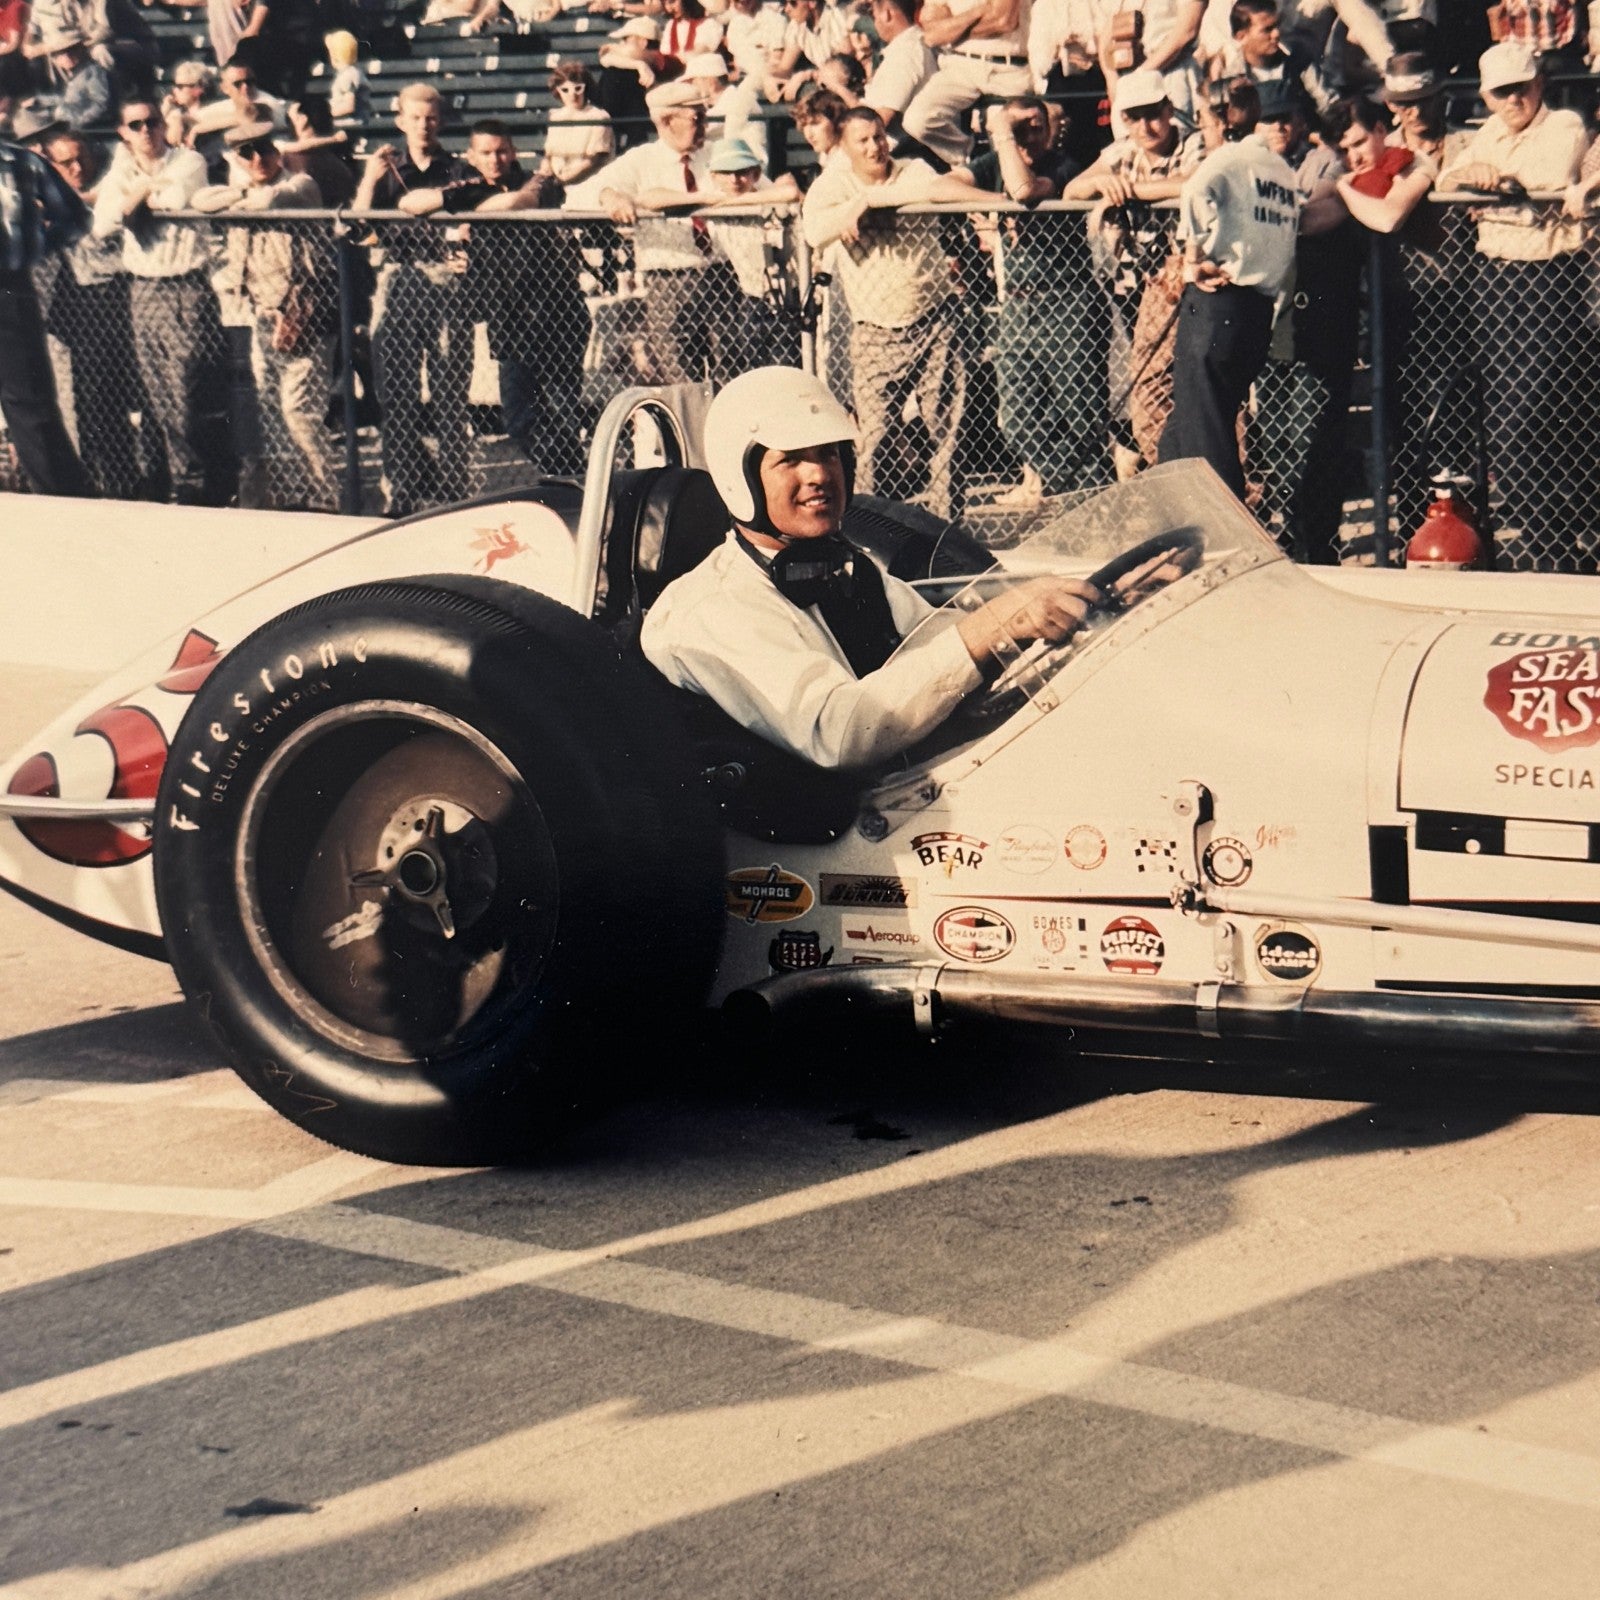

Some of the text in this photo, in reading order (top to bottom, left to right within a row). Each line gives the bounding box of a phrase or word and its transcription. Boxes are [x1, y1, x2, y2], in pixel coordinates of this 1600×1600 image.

[1507, 686, 1600, 737] FAS
[170, 637, 368, 831] Firestone
[211, 680, 332, 802] DELUXE CHAMPION
[1495, 764, 1595, 789] SPECIA
[917, 845, 983, 870] BEAR
[742, 886, 791, 898] MONROE
[1033, 916, 1073, 930] BOWES
[865, 925, 921, 946] Aeroquip
[947, 928, 1003, 941] CHAMPION
[1101, 930, 1163, 949] PERFECT
[1105, 943, 1161, 960] CIRCLE
[1261, 957, 1317, 968] CLAMPS
